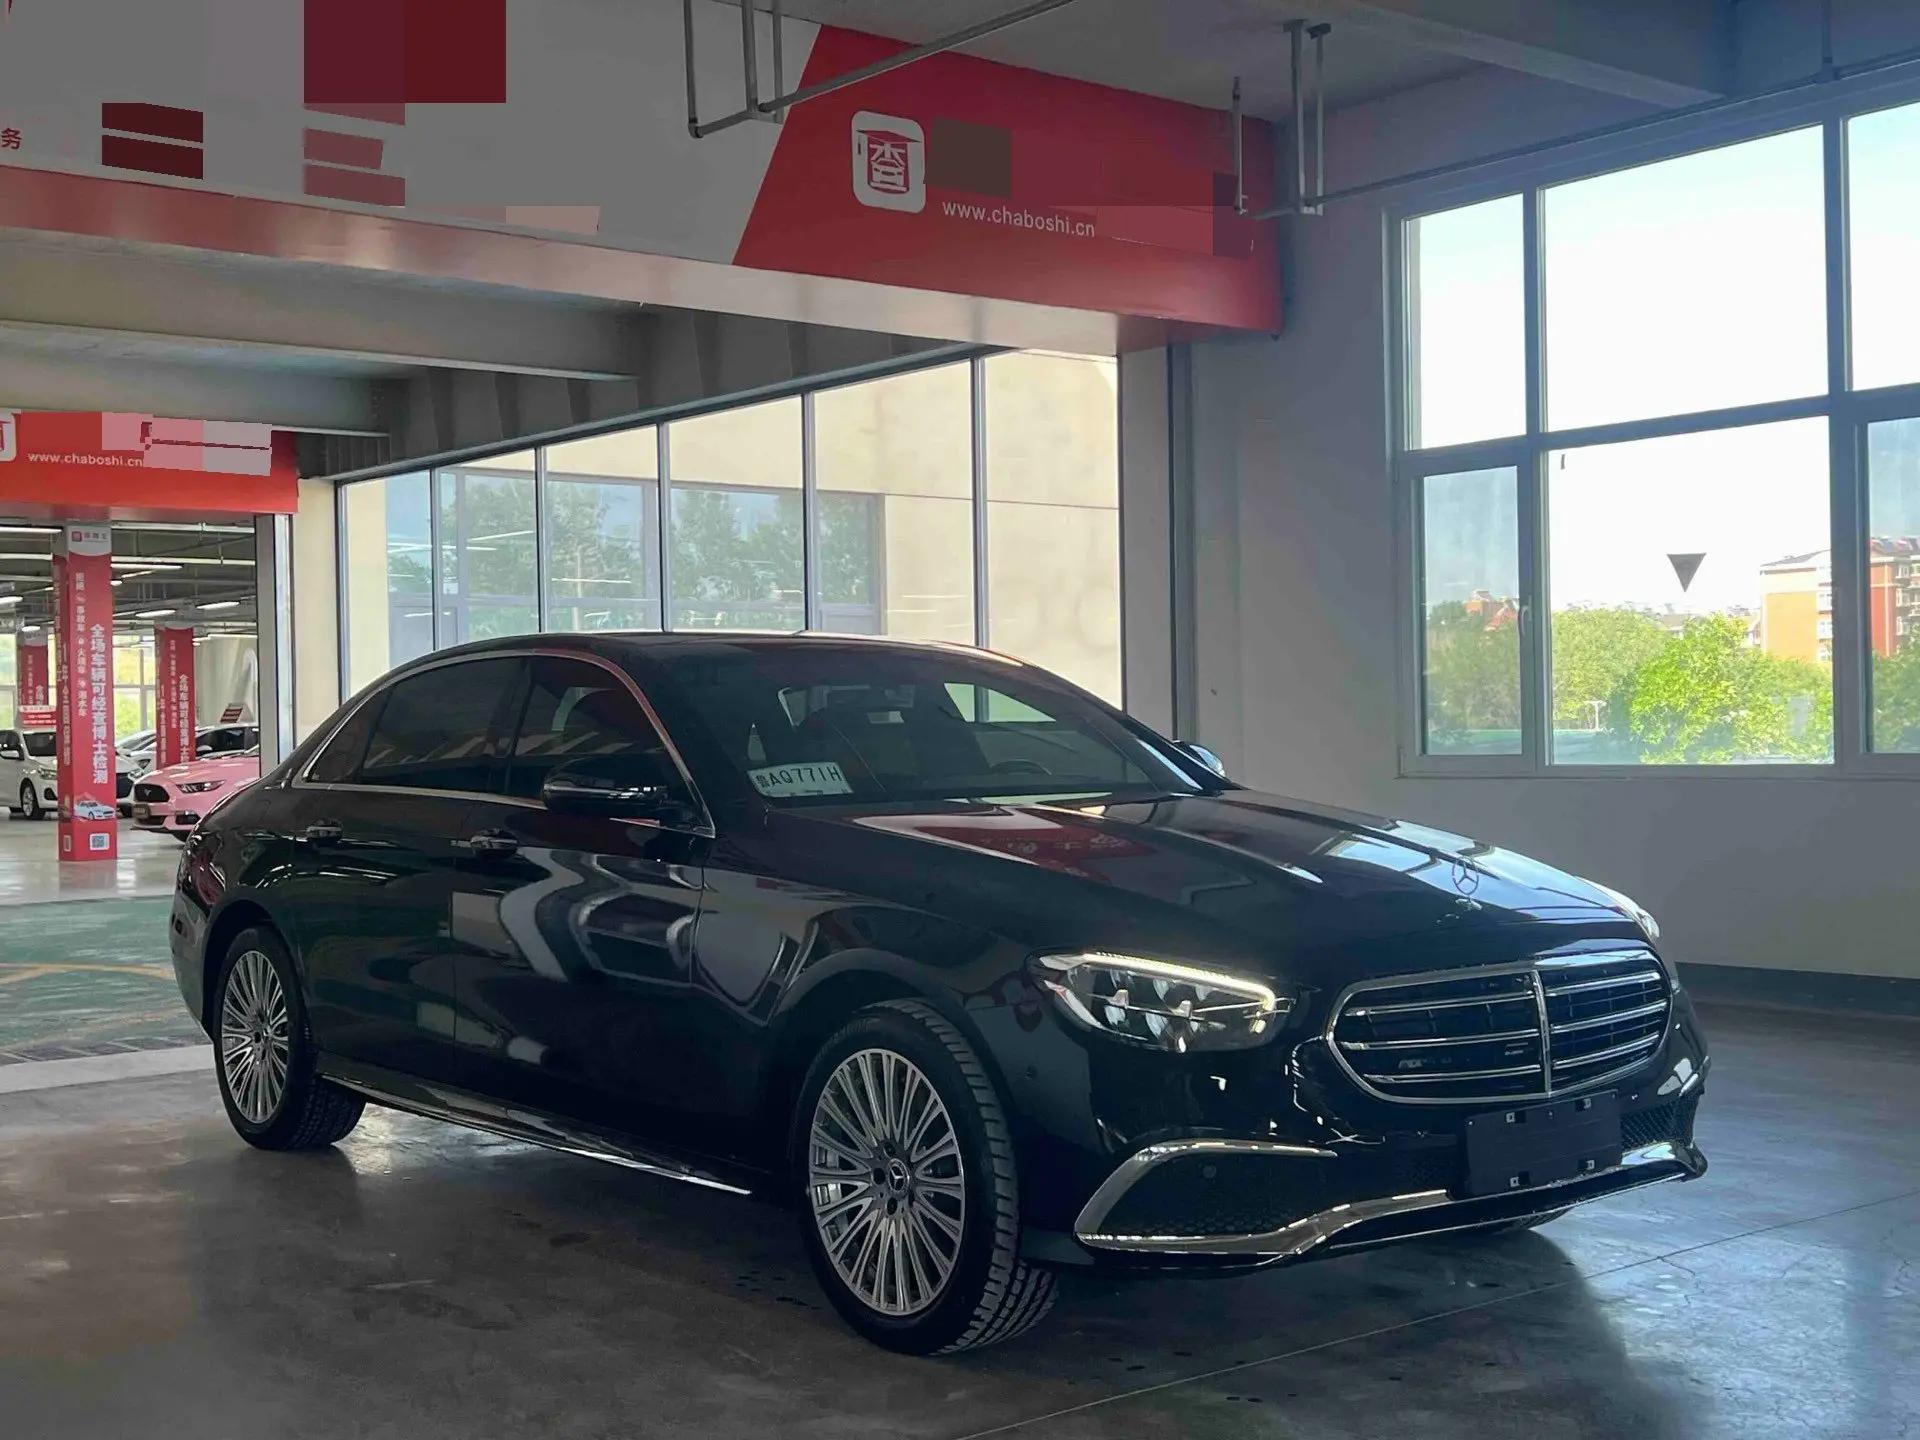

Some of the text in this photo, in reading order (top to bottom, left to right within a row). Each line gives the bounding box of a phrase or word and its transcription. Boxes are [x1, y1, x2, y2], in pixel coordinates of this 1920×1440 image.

[1, 128, 22, 150] 务
[942, 200, 1096, 238] www.chaboshi.cn
[27, 452, 143, 468] www.chaboshi.cn
